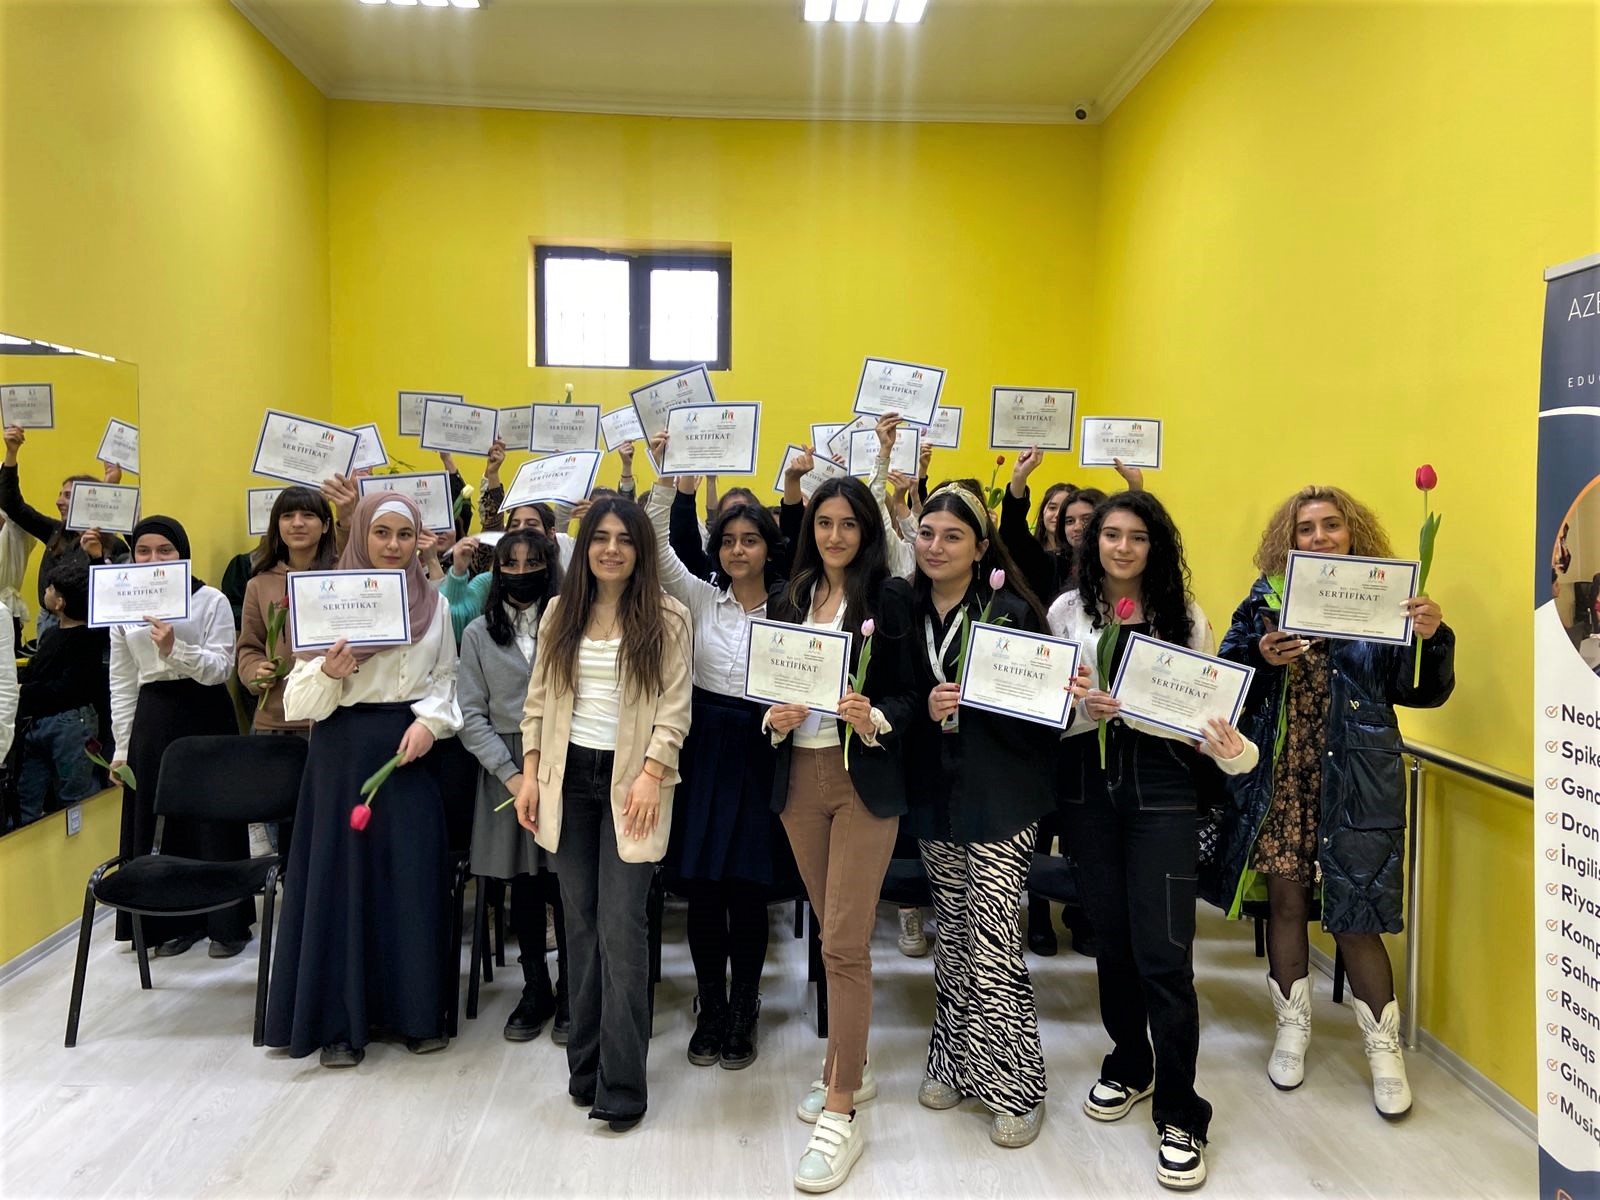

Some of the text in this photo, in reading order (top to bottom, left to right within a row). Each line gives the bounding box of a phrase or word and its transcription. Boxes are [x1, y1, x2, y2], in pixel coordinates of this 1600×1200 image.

[1568, 373, 1600, 388] EDU
[1562, 812, 1600, 841] Dron
[1562, 843, 1600, 880] İngili
[1561, 990, 1600, 1031] Rəsm
[1561, 1026, 1596, 1064] Rəqs
[1560, 1062, 1600, 1107] Gimn
